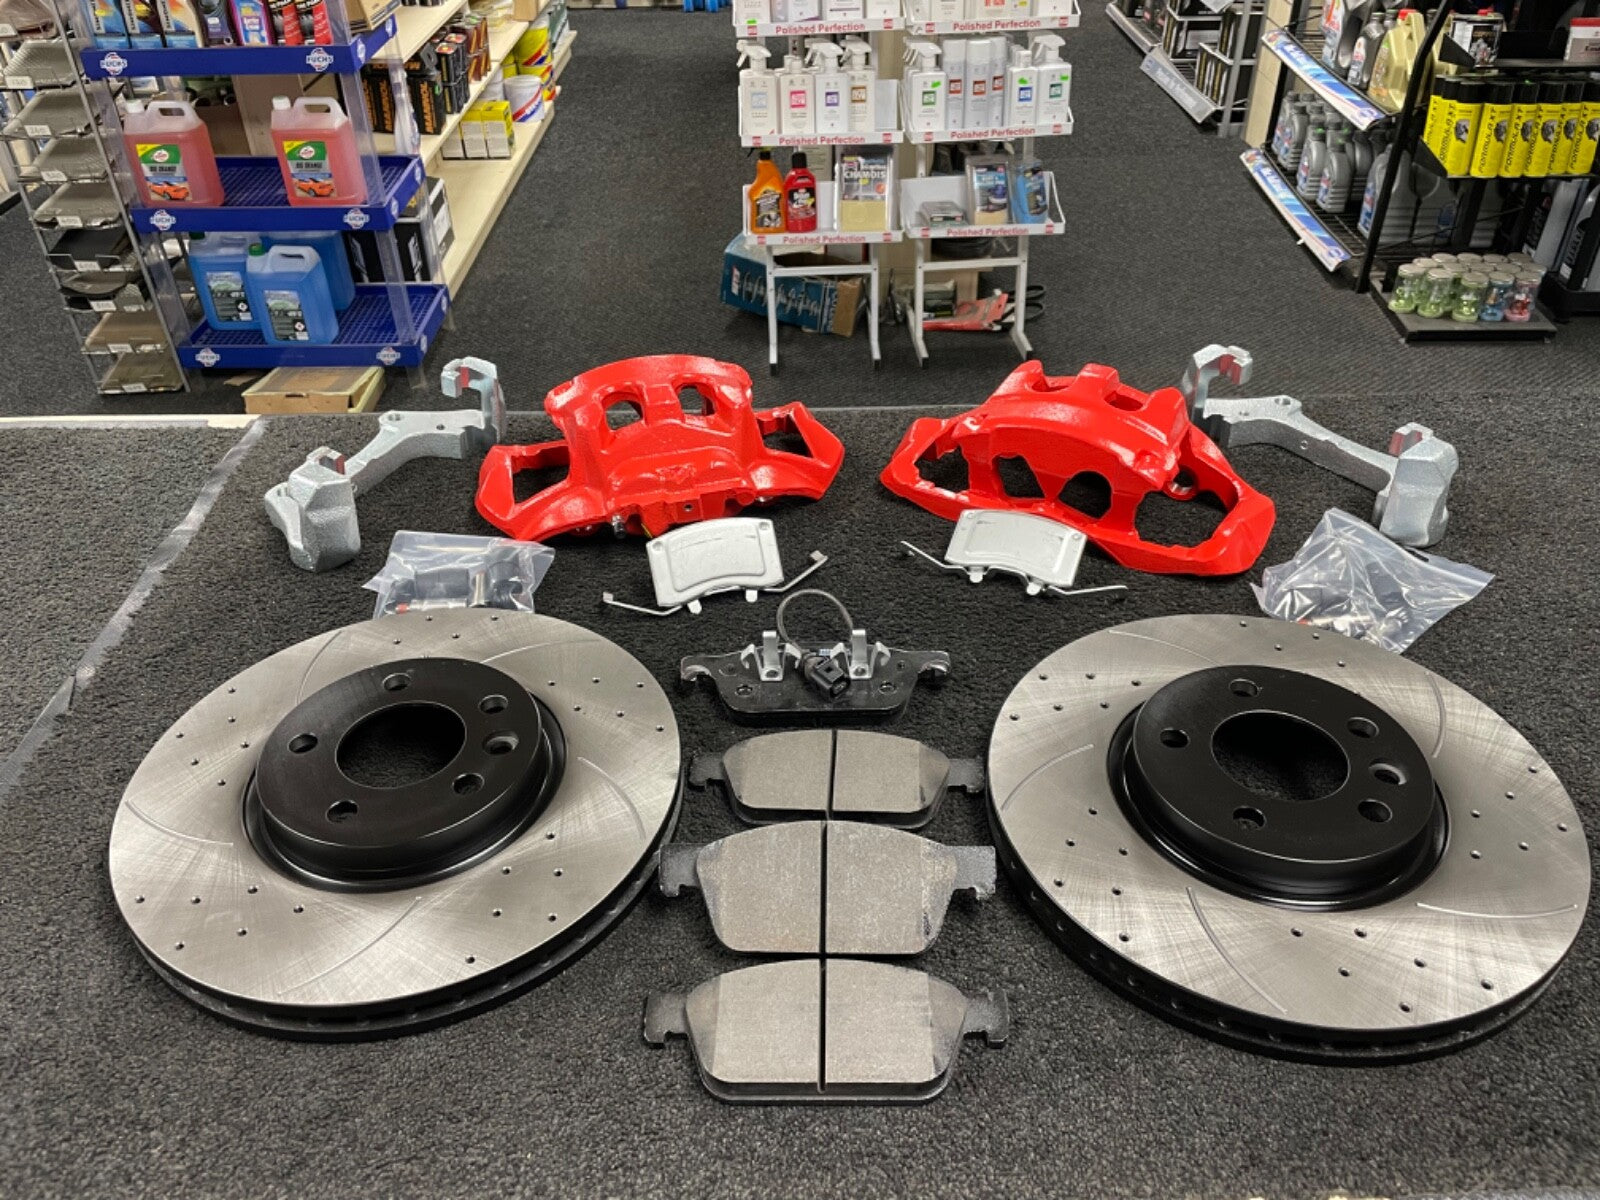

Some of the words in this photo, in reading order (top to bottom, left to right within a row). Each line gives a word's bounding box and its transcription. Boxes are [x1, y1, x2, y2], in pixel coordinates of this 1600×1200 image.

[775, 25, 816, 34] Polished
[818, 23, 866, 33] Perfection
[953, 21, 993, 31] Polished
[995, 19, 1041, 29] Perfection
[950, 130, 990, 139] Polished
[991, 127, 1036, 137] Perfection
[779, 136, 818, 145] Polished
[820, 135, 866, 144] Perfection
[843, 170, 887, 179] CHAMOIS
[946, 228, 984, 237] Polished
[985, 226, 1029, 235] Perfection
[783, 235, 821, 244] Polished
[823, 234, 866, 243] Perfection
